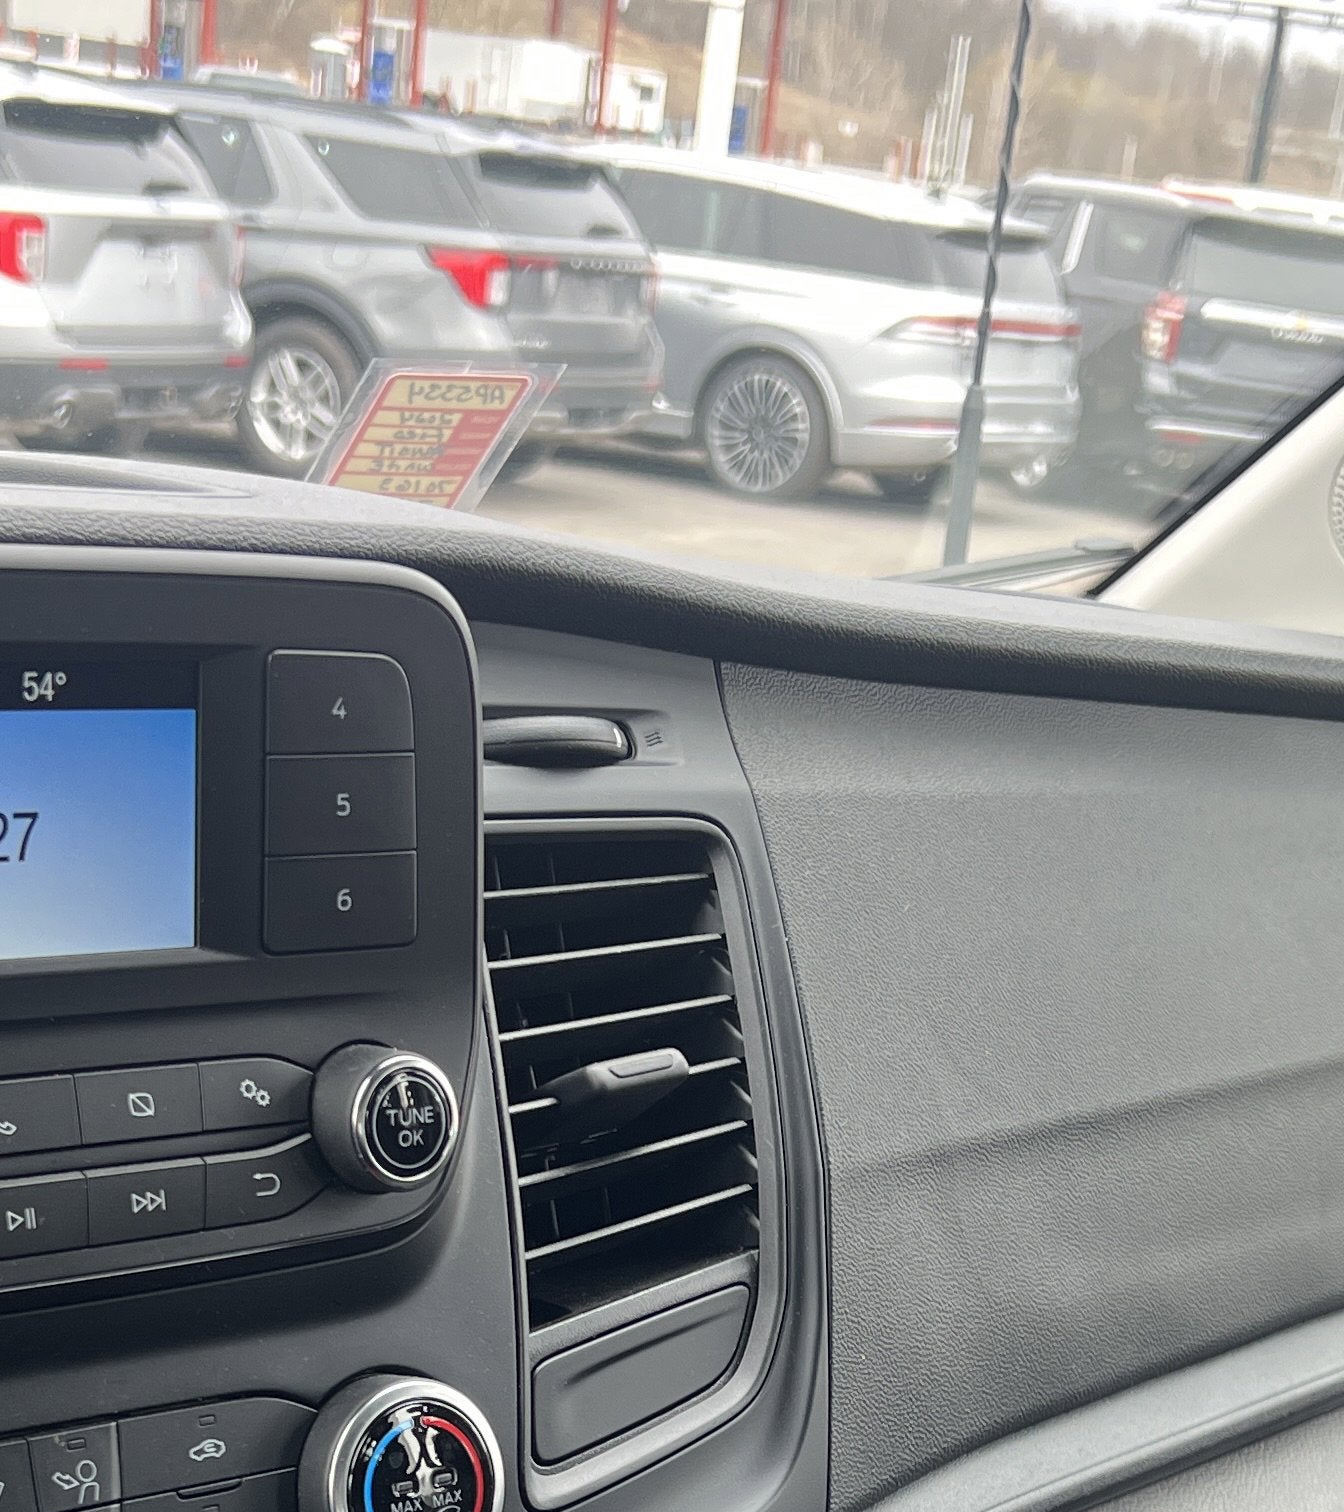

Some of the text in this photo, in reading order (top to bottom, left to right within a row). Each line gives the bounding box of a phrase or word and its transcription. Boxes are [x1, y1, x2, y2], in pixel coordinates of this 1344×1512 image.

[330, 697, 349, 720] 4
[335, 792, 352, 817] 5
[335, 888, 354, 913] 6
[386, 1105, 435, 1127] TUNE
[397, 1128, 425, 1148] OK
[432, 1489, 463, 1508] MAX
